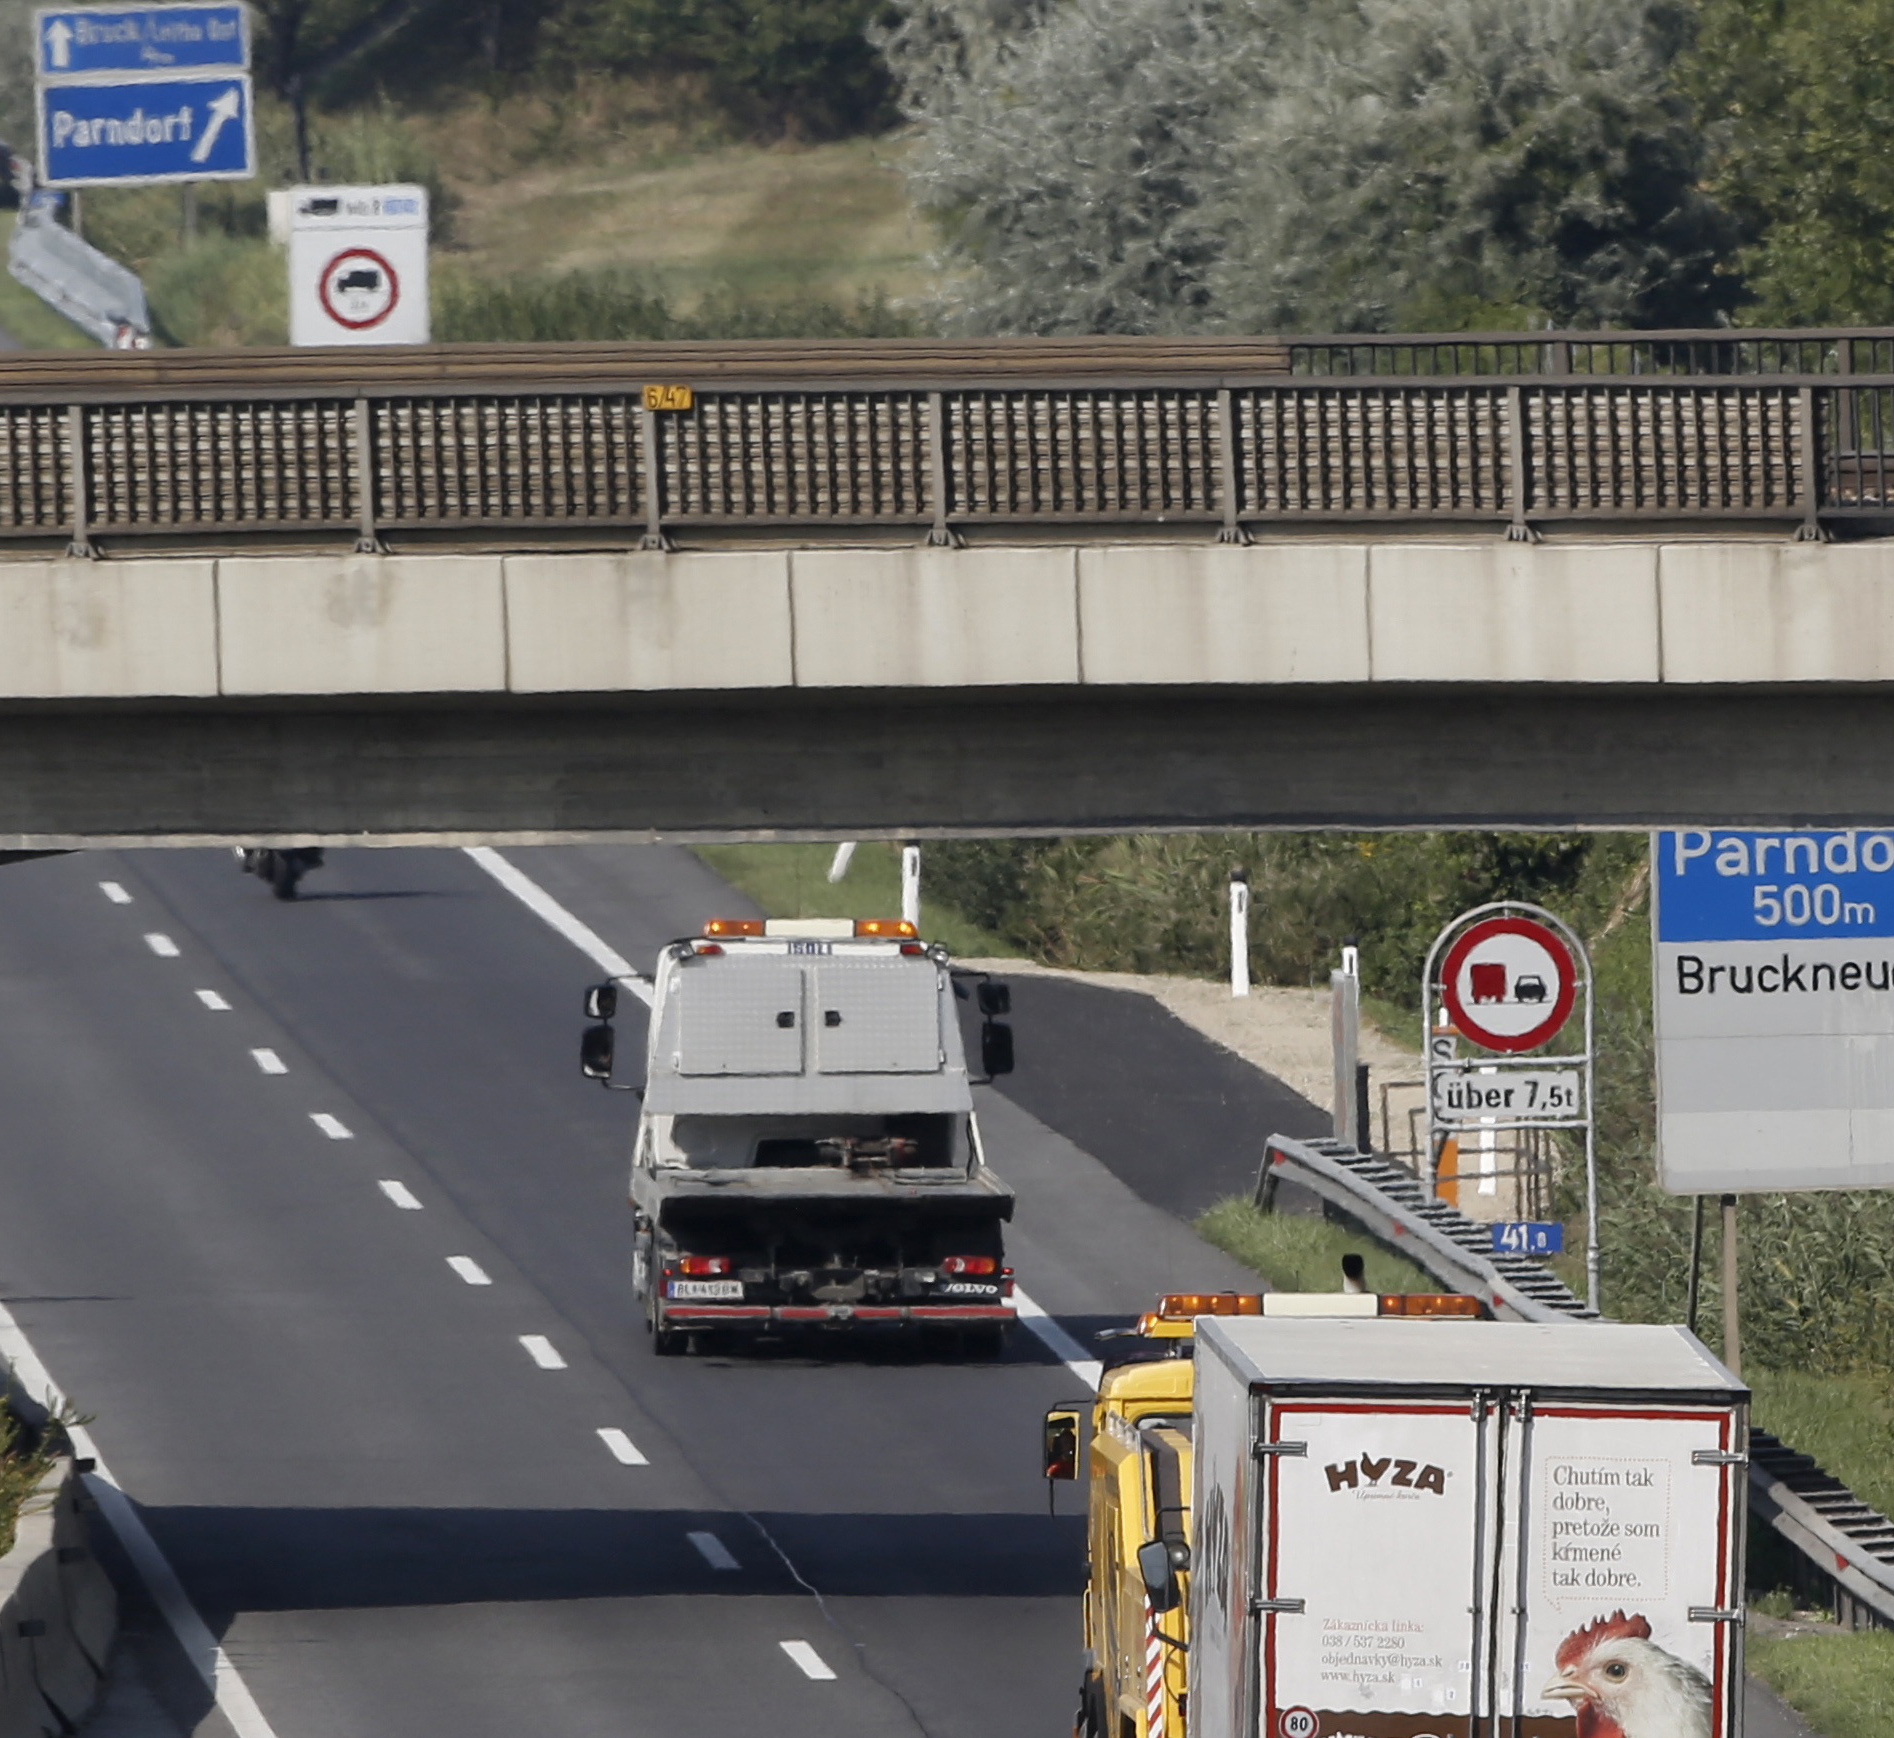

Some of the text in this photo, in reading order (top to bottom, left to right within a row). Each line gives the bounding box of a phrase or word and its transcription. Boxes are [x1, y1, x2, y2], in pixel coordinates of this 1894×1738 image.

[52, 105, 192, 148] Parndorf
[1754, 883, 1875, 926] 500m
[1447, 1081, 1574, 1110] über 7,5t
[1324, 1451, 1445, 1495] HYZA
[1553, 1464, 1654, 1487] Chutím tak
[1552, 1491, 1610, 1516] dobre,
[1552, 1518, 1660, 1539] pretože som
[1552, 1541, 1621, 1561] kŕmené
[1552, 1567, 1641, 1587] tak dobre.
[1392, 1619, 1424, 1632] linka:
[1322, 1635, 1343, 1647] 038
[1353, 1635, 1374, 1648] 537
[1377, 1636, 1405, 1649] 2280
[1321, 1653, 1442, 1668] objednavky@hyza.sk
[1321, 1670, 1395, 1683] www.hyza.sk
[1290, 1716, 1307, 1731] 80
